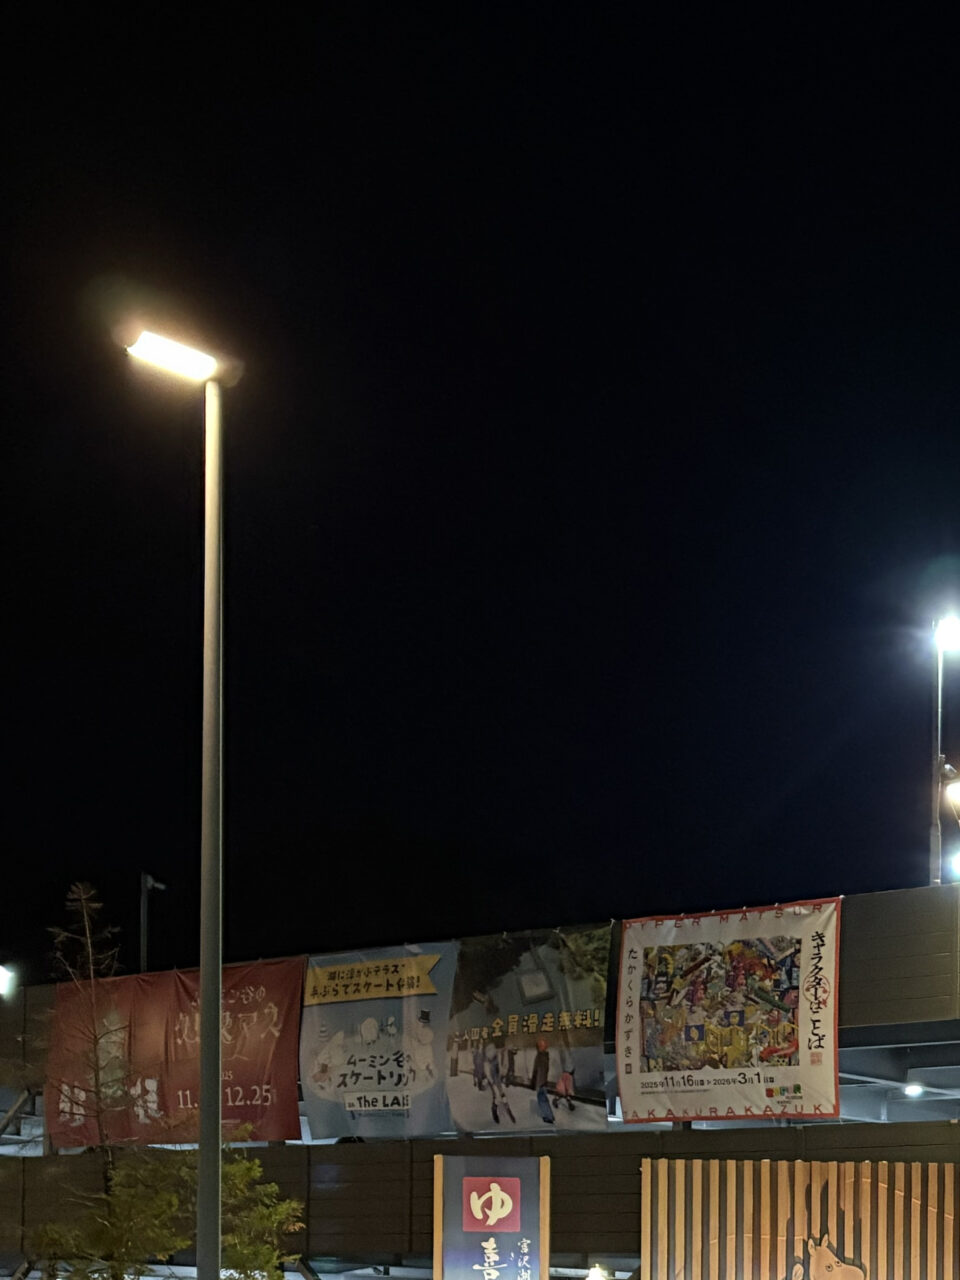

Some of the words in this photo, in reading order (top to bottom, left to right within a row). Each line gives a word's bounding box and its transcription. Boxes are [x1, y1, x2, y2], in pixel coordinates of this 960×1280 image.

[720, 904, 823, 924] MATSUR
[327, 963, 406, 981] 湖に浮かぶテラス
[225, 1085, 272, 1106] 12.25
[357, 1096, 379, 1107] The
[470, 1182, 513, 1225] ゆ
